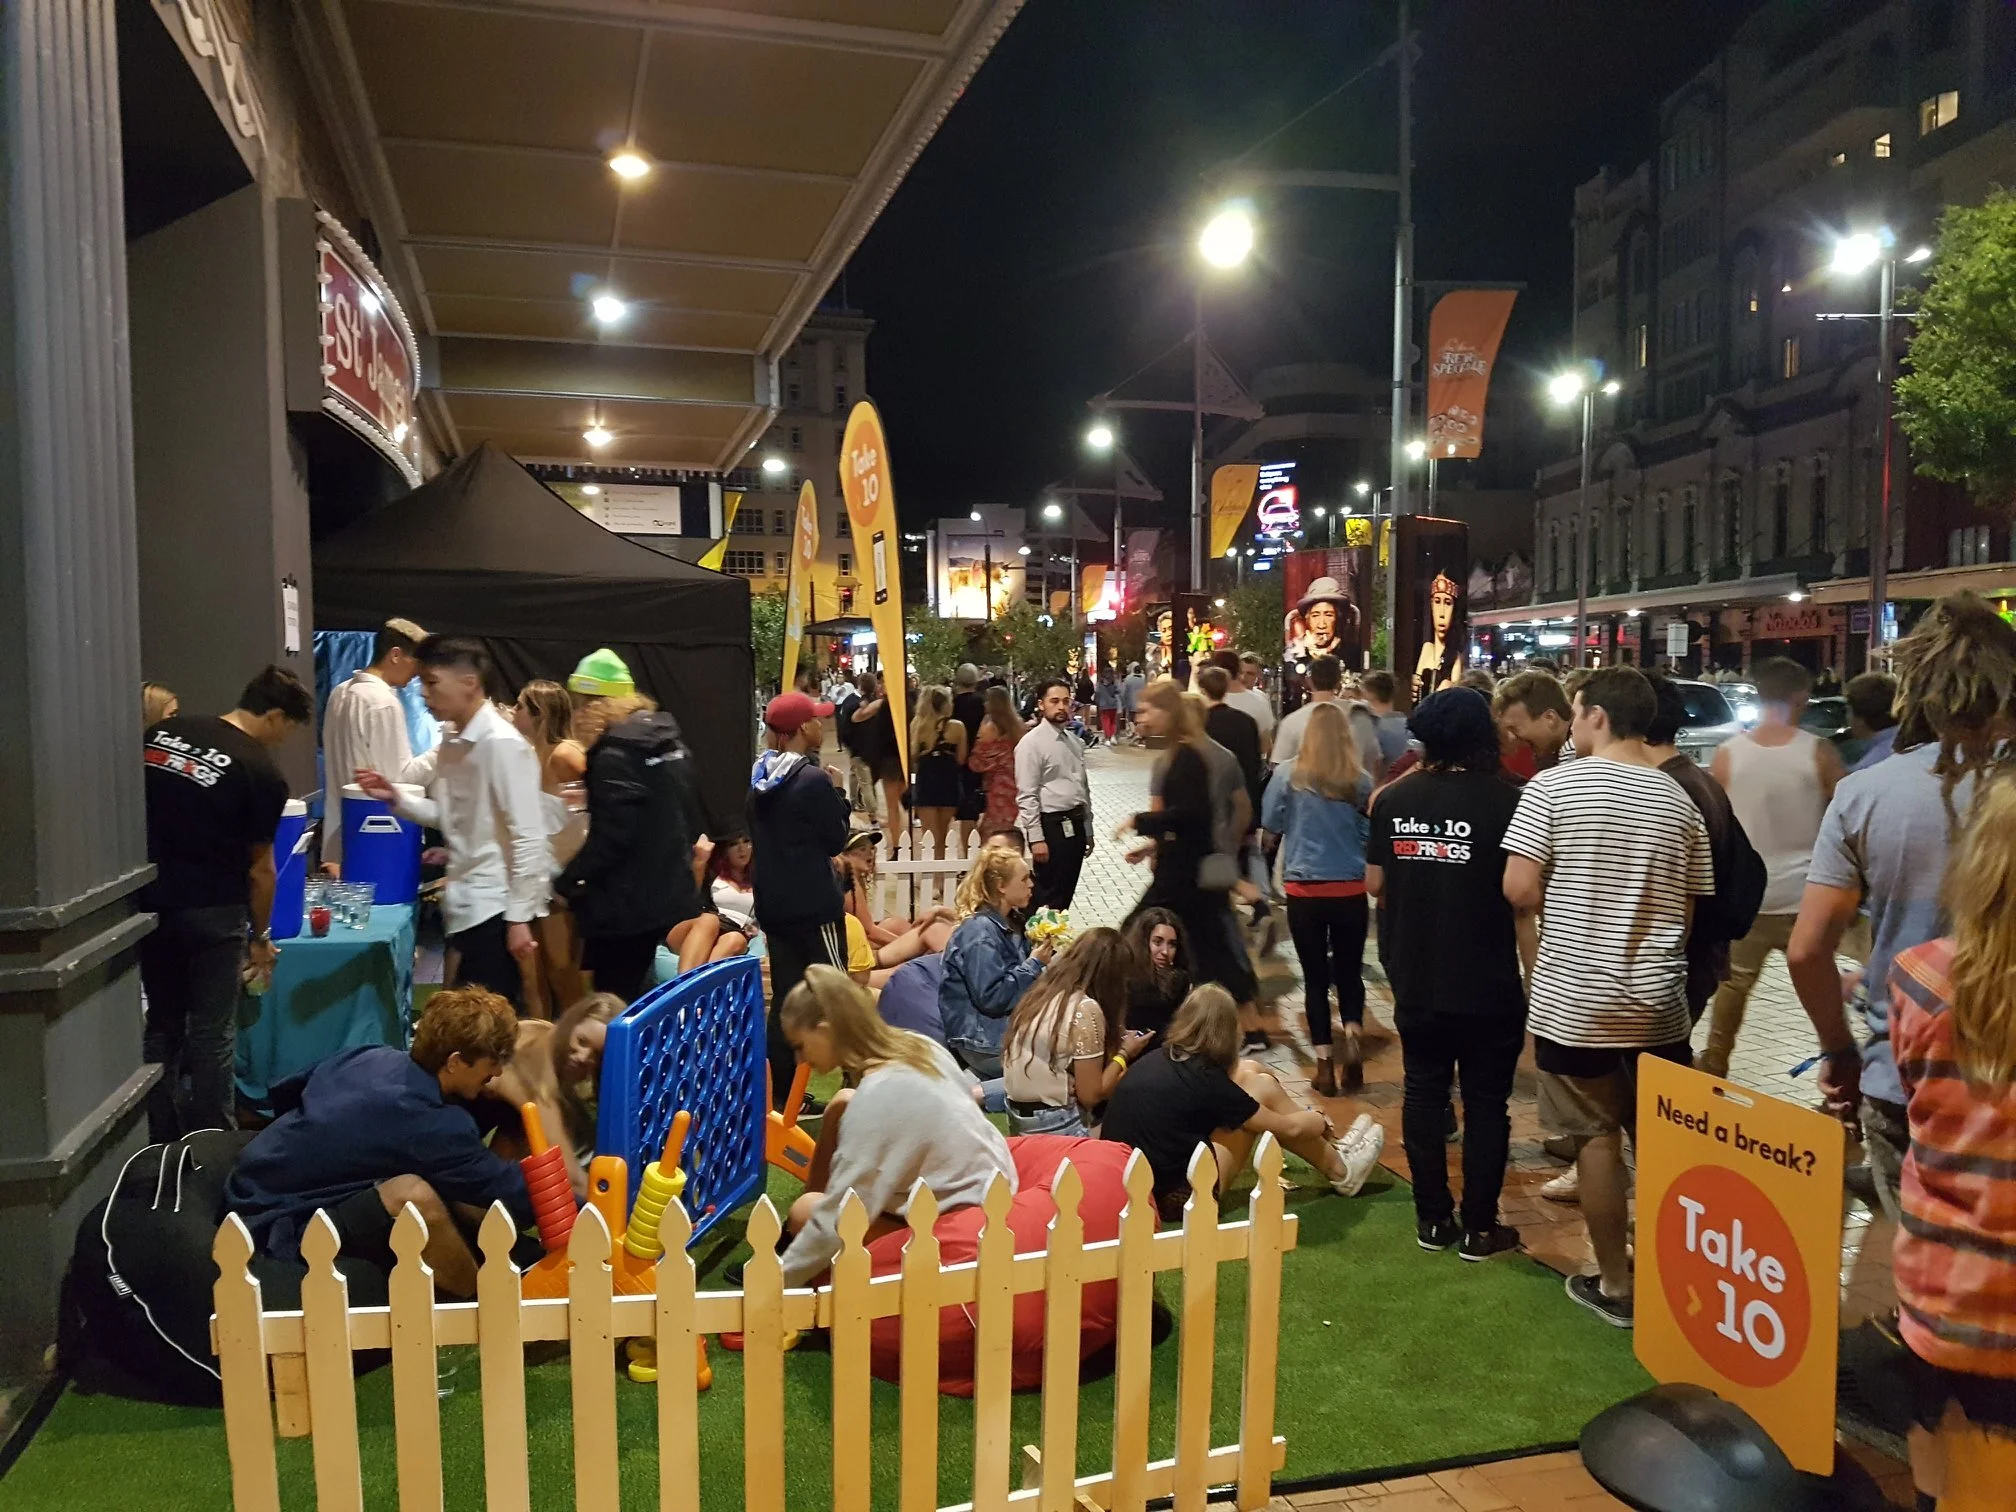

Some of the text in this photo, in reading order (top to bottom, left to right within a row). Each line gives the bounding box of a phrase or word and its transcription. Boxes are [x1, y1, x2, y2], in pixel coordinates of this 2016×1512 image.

[333, 292, 363, 379] St
[862, 473, 879, 507] 10
[153, 730, 232, 767] Take 10
[1392, 817, 1472, 838] Take 10
[1657, 1094, 1816, 1176] Need a break?
[1678, 1194, 1787, 1294] Take
[1715, 1279, 1786, 1359] 10
